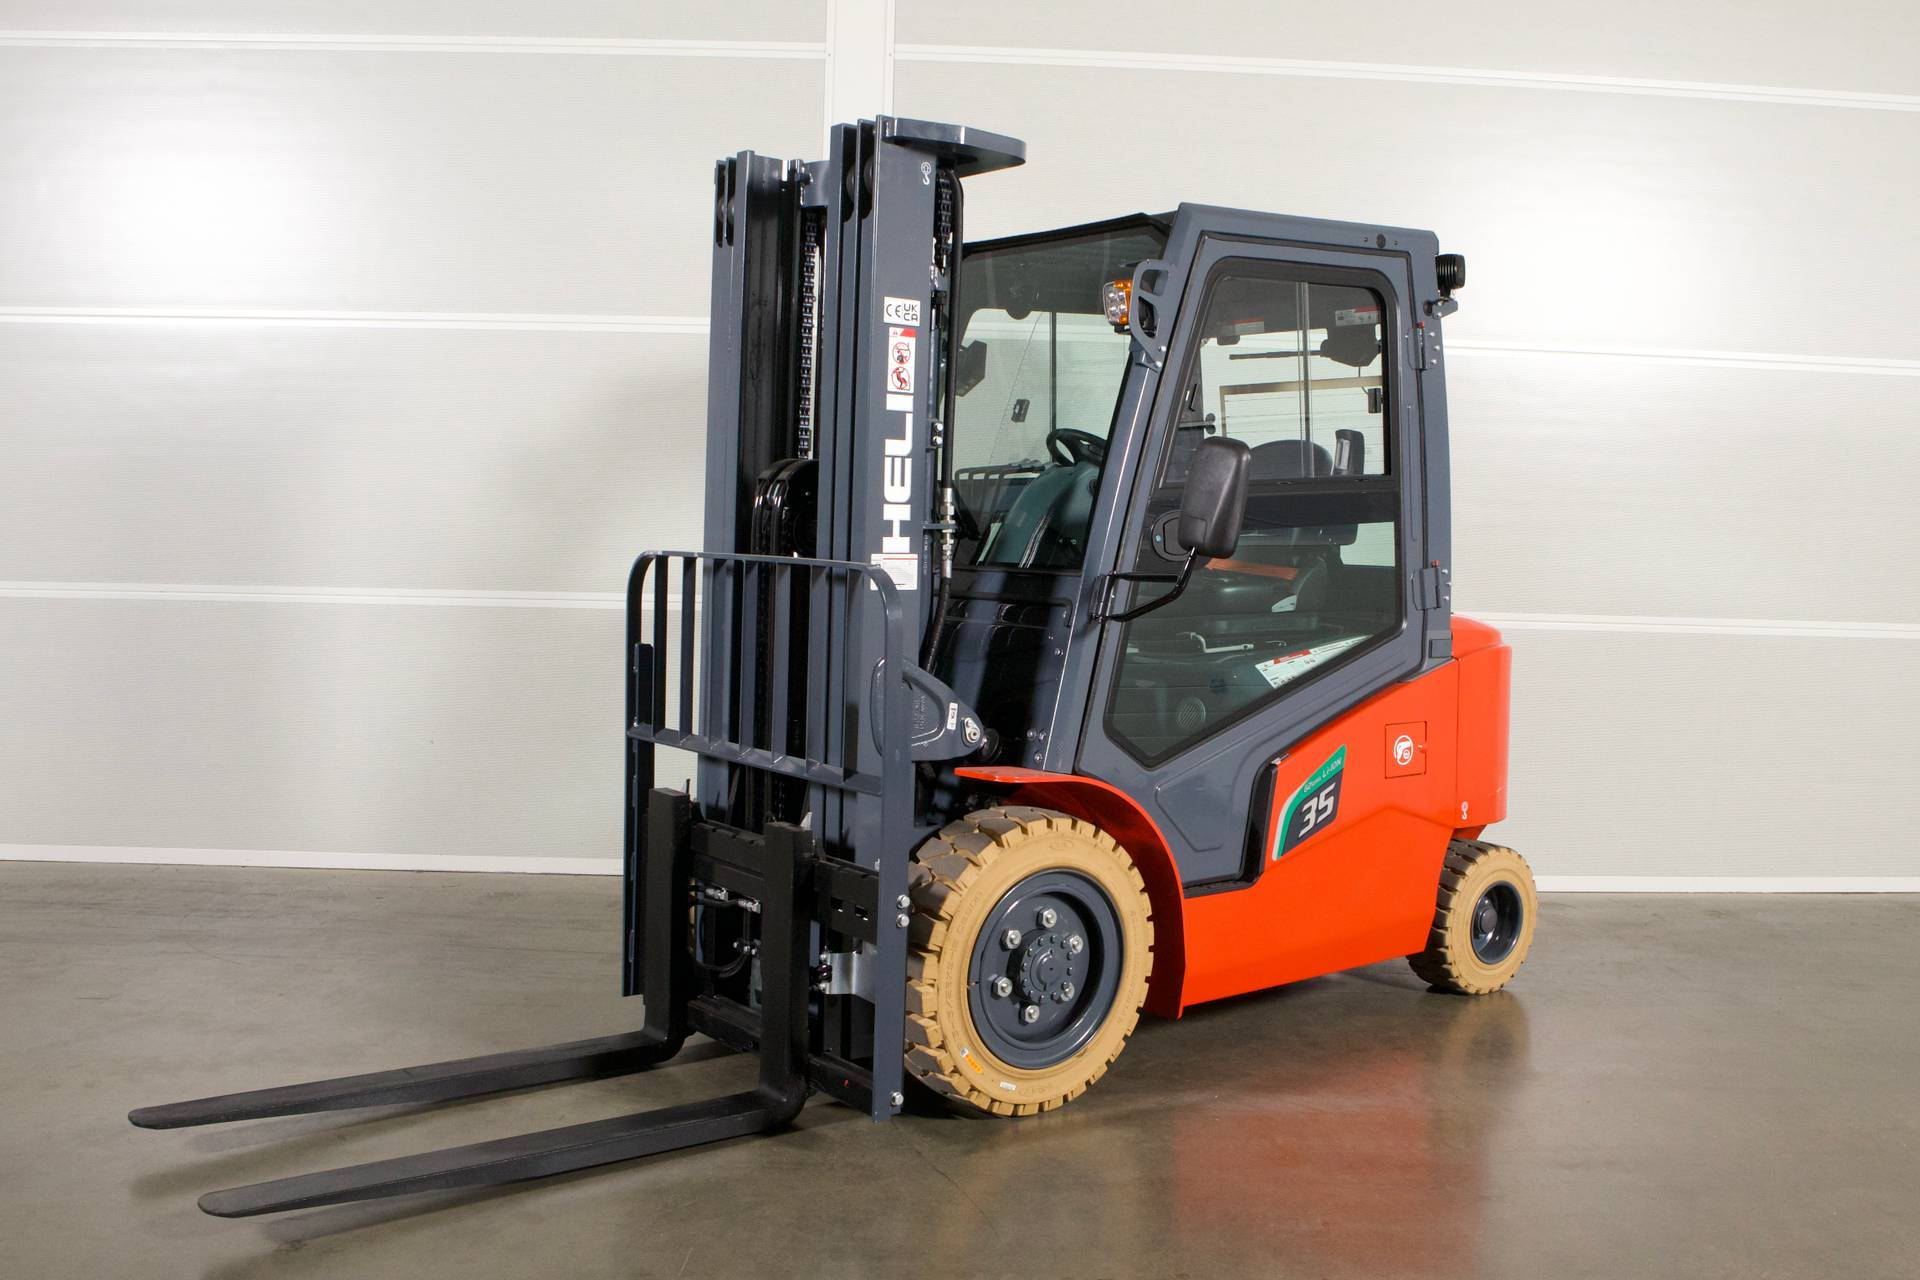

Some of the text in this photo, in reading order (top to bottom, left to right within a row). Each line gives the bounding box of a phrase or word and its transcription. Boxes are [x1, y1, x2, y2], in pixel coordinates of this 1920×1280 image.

[903, 303, 918, 313] UK
[903, 312, 919, 322] CA
[882, 394, 914, 553] HELI
[1298, 783, 1336, 838] 35
